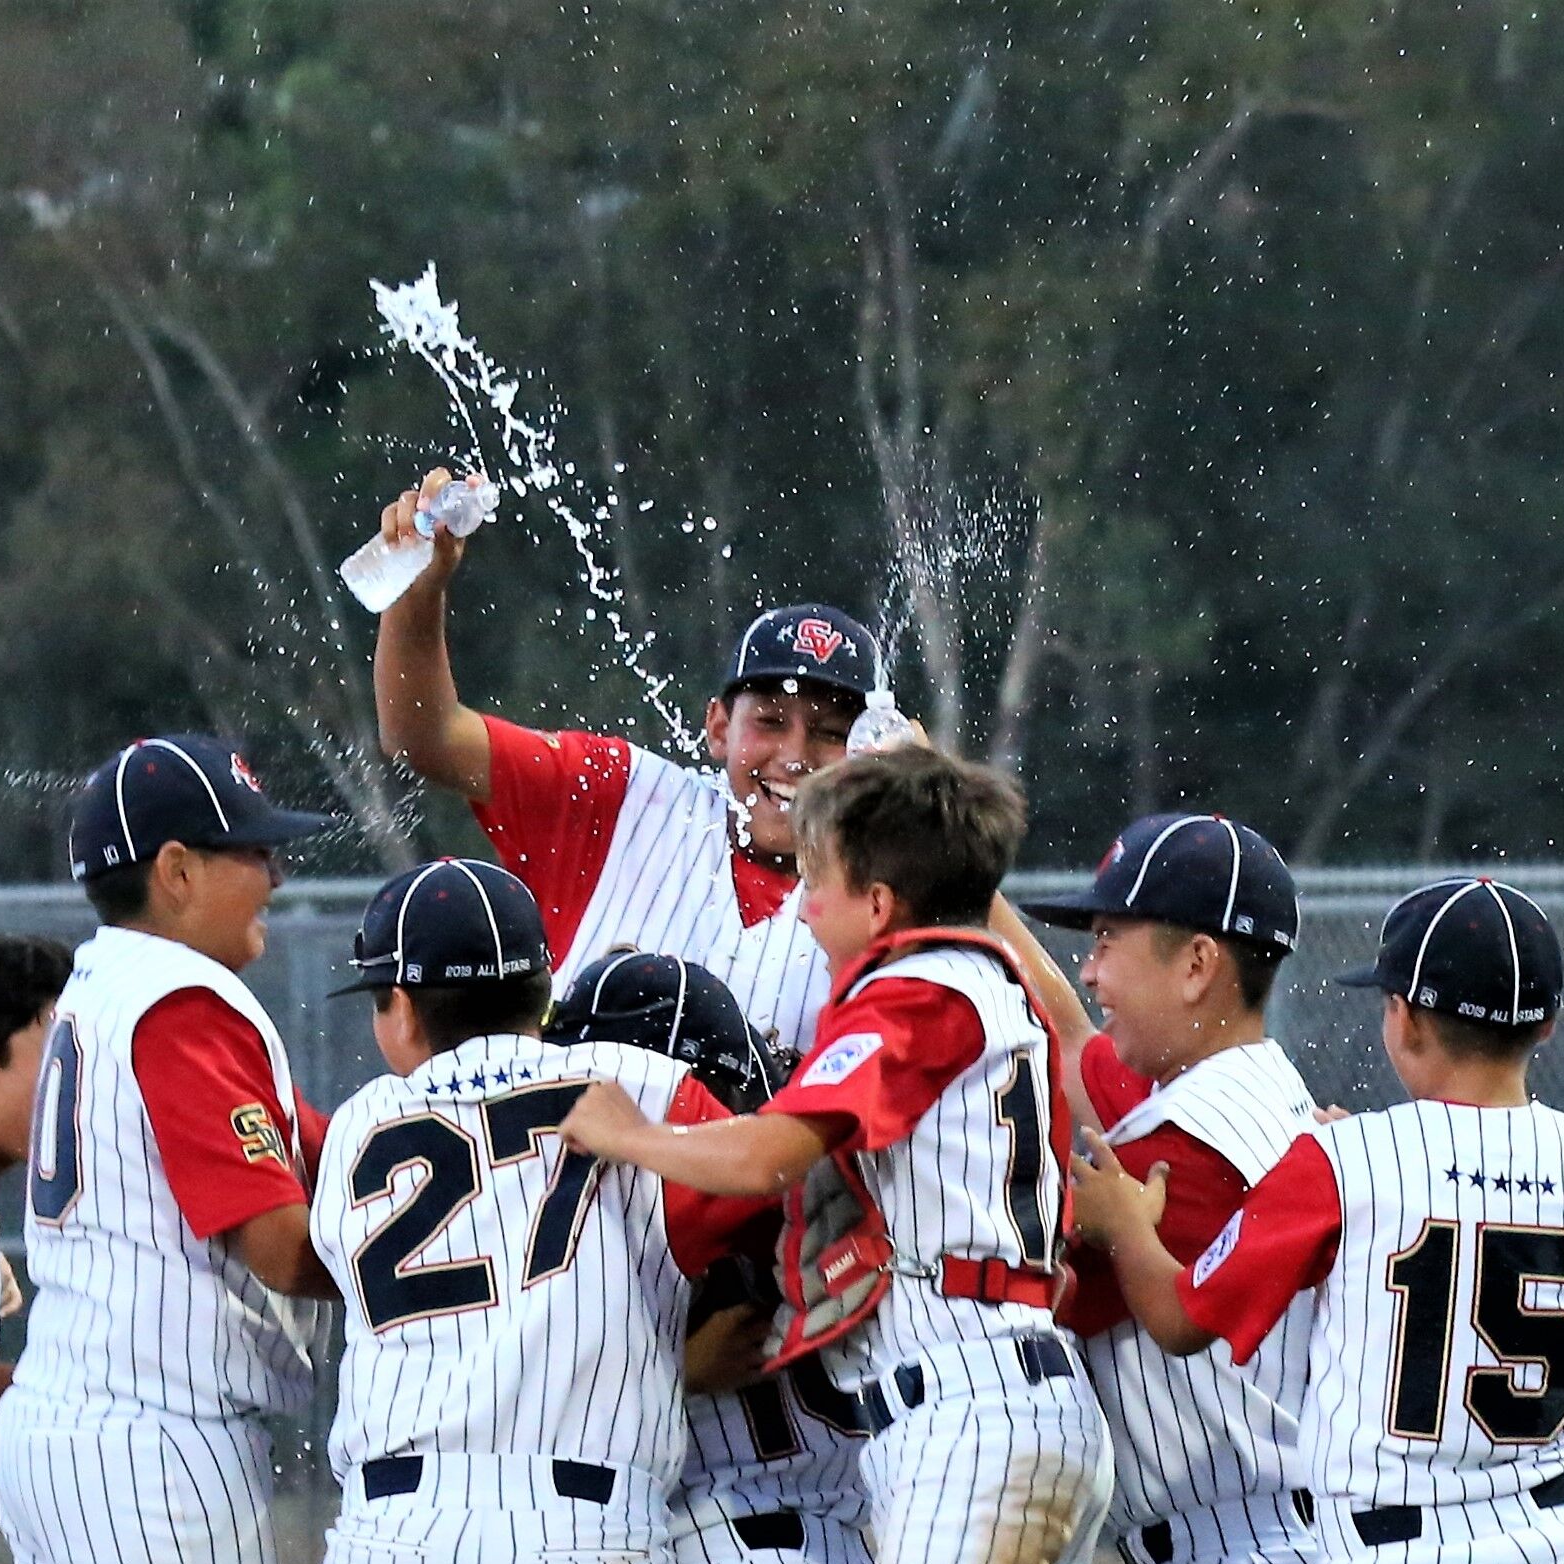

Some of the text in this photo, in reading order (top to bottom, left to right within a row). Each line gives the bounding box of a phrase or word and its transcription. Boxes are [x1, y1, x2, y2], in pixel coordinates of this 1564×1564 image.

[793, 618, 843, 664] SV
[445, 958, 531, 979] 2019 ALL STARS
[1457, 1002, 1545, 1023] 2019 ALL STARS
[230, 1101, 291, 1172] SV
[348, 1078, 607, 1335] 27
